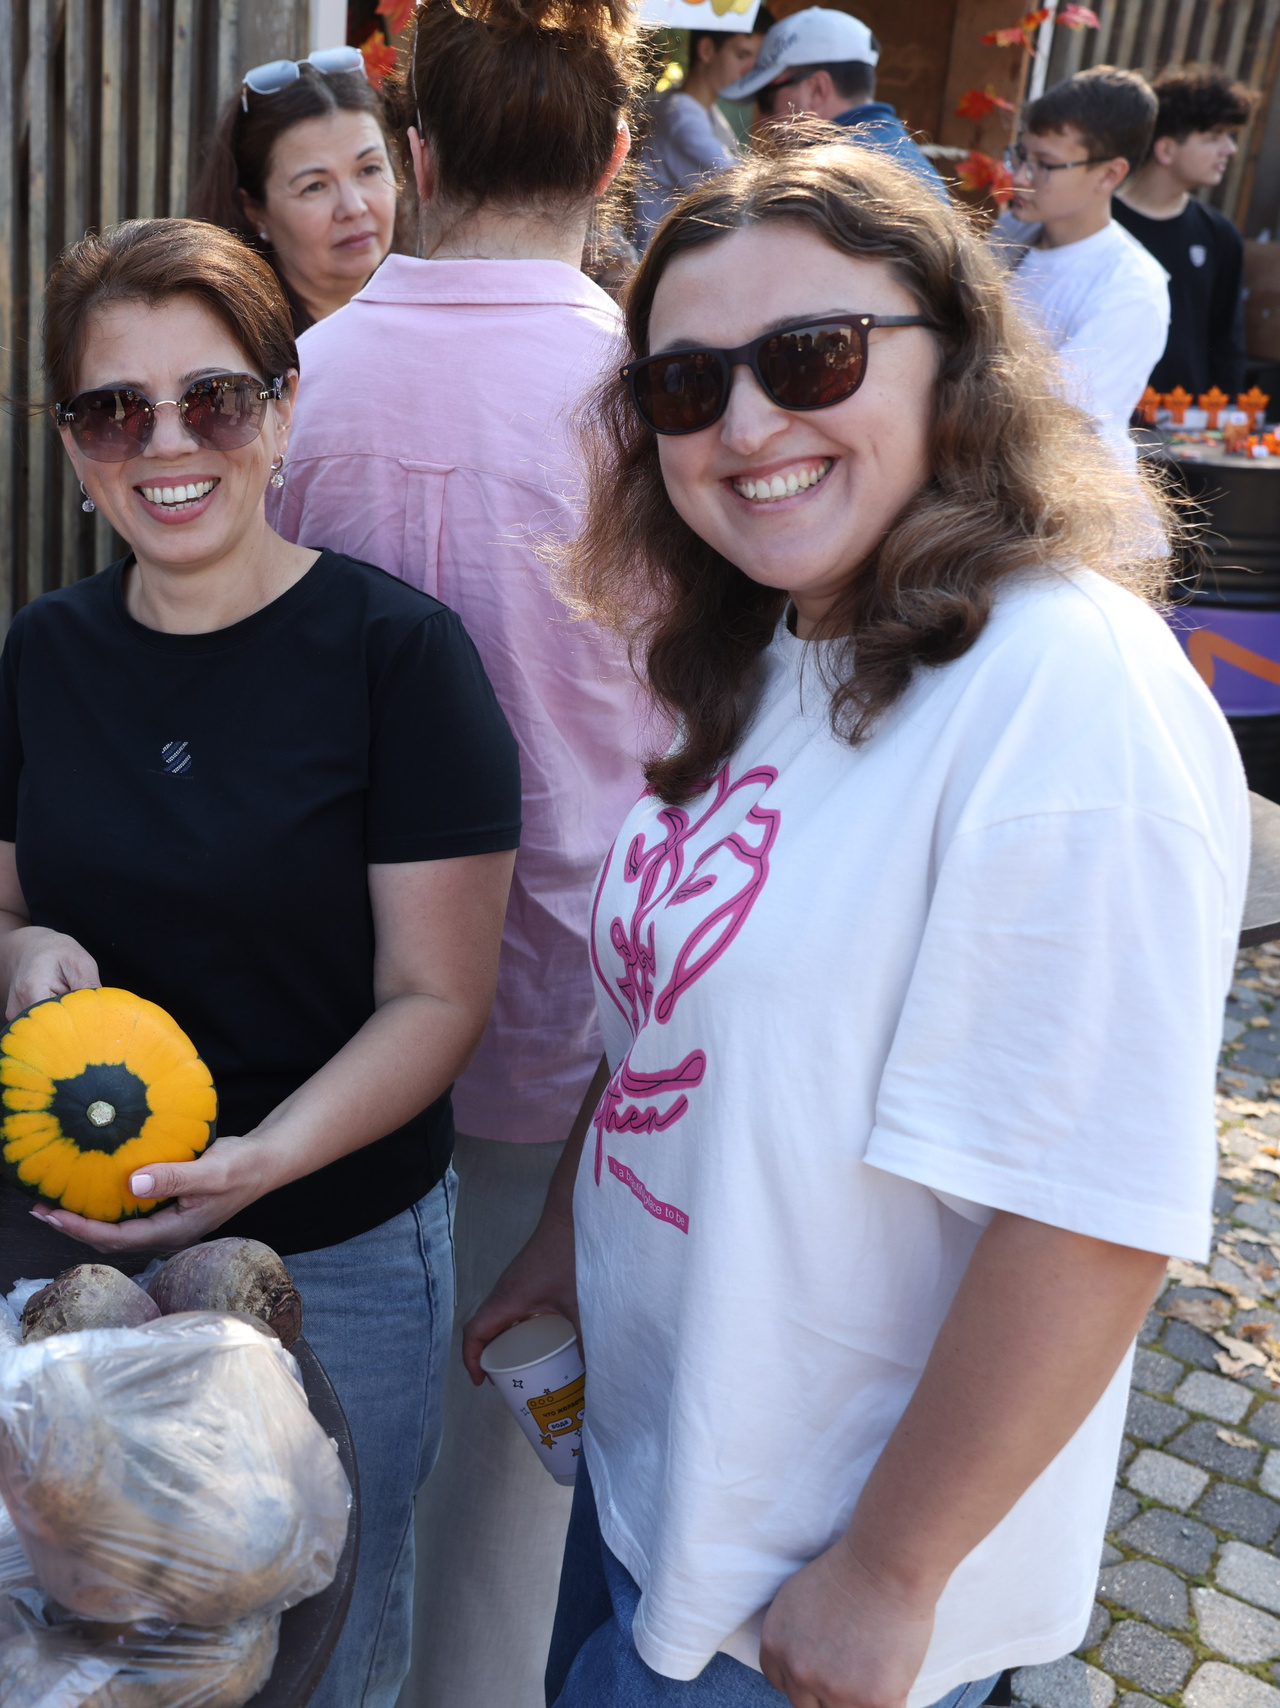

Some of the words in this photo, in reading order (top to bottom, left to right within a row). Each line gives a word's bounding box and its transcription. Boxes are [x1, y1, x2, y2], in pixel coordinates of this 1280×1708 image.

[618, 1168, 624, 1178] a
[643, 1193, 662, 1215] place
[665, 1206, 674, 1219] to
[676, 1211, 685, 1227] be
